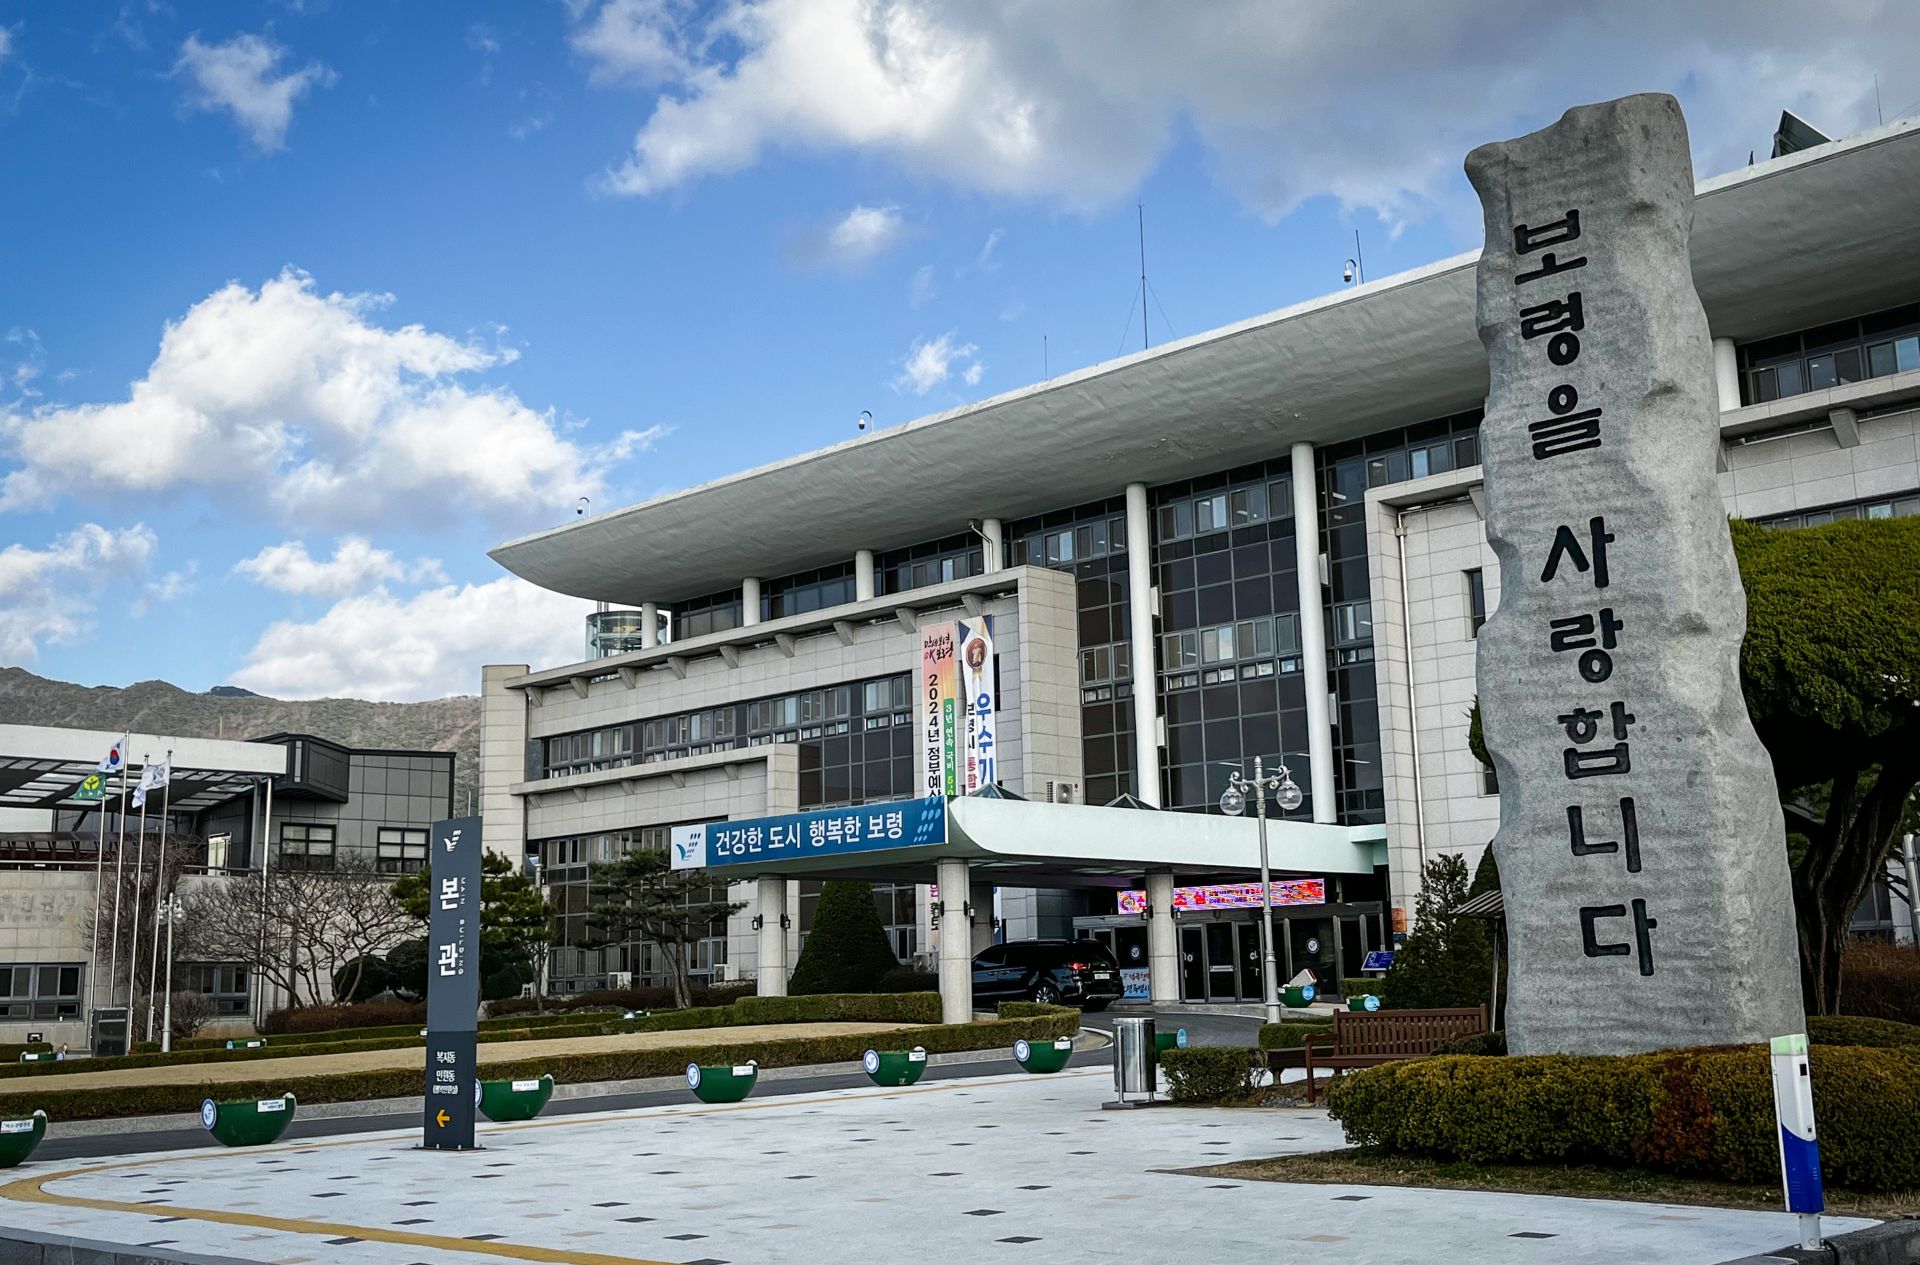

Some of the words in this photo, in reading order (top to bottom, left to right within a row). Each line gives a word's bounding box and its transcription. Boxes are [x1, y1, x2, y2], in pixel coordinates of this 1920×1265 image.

[1513, 208, 1603, 461] 보령을
[927, 673, 940, 743] 2024년
[1540, 515, 1658, 976] 사랑합니다
[715, 826, 763, 856] 건강한
[768, 822, 801, 849] 도시
[809, 815, 862, 847] 행복한
[867, 810, 904, 840] 보령
